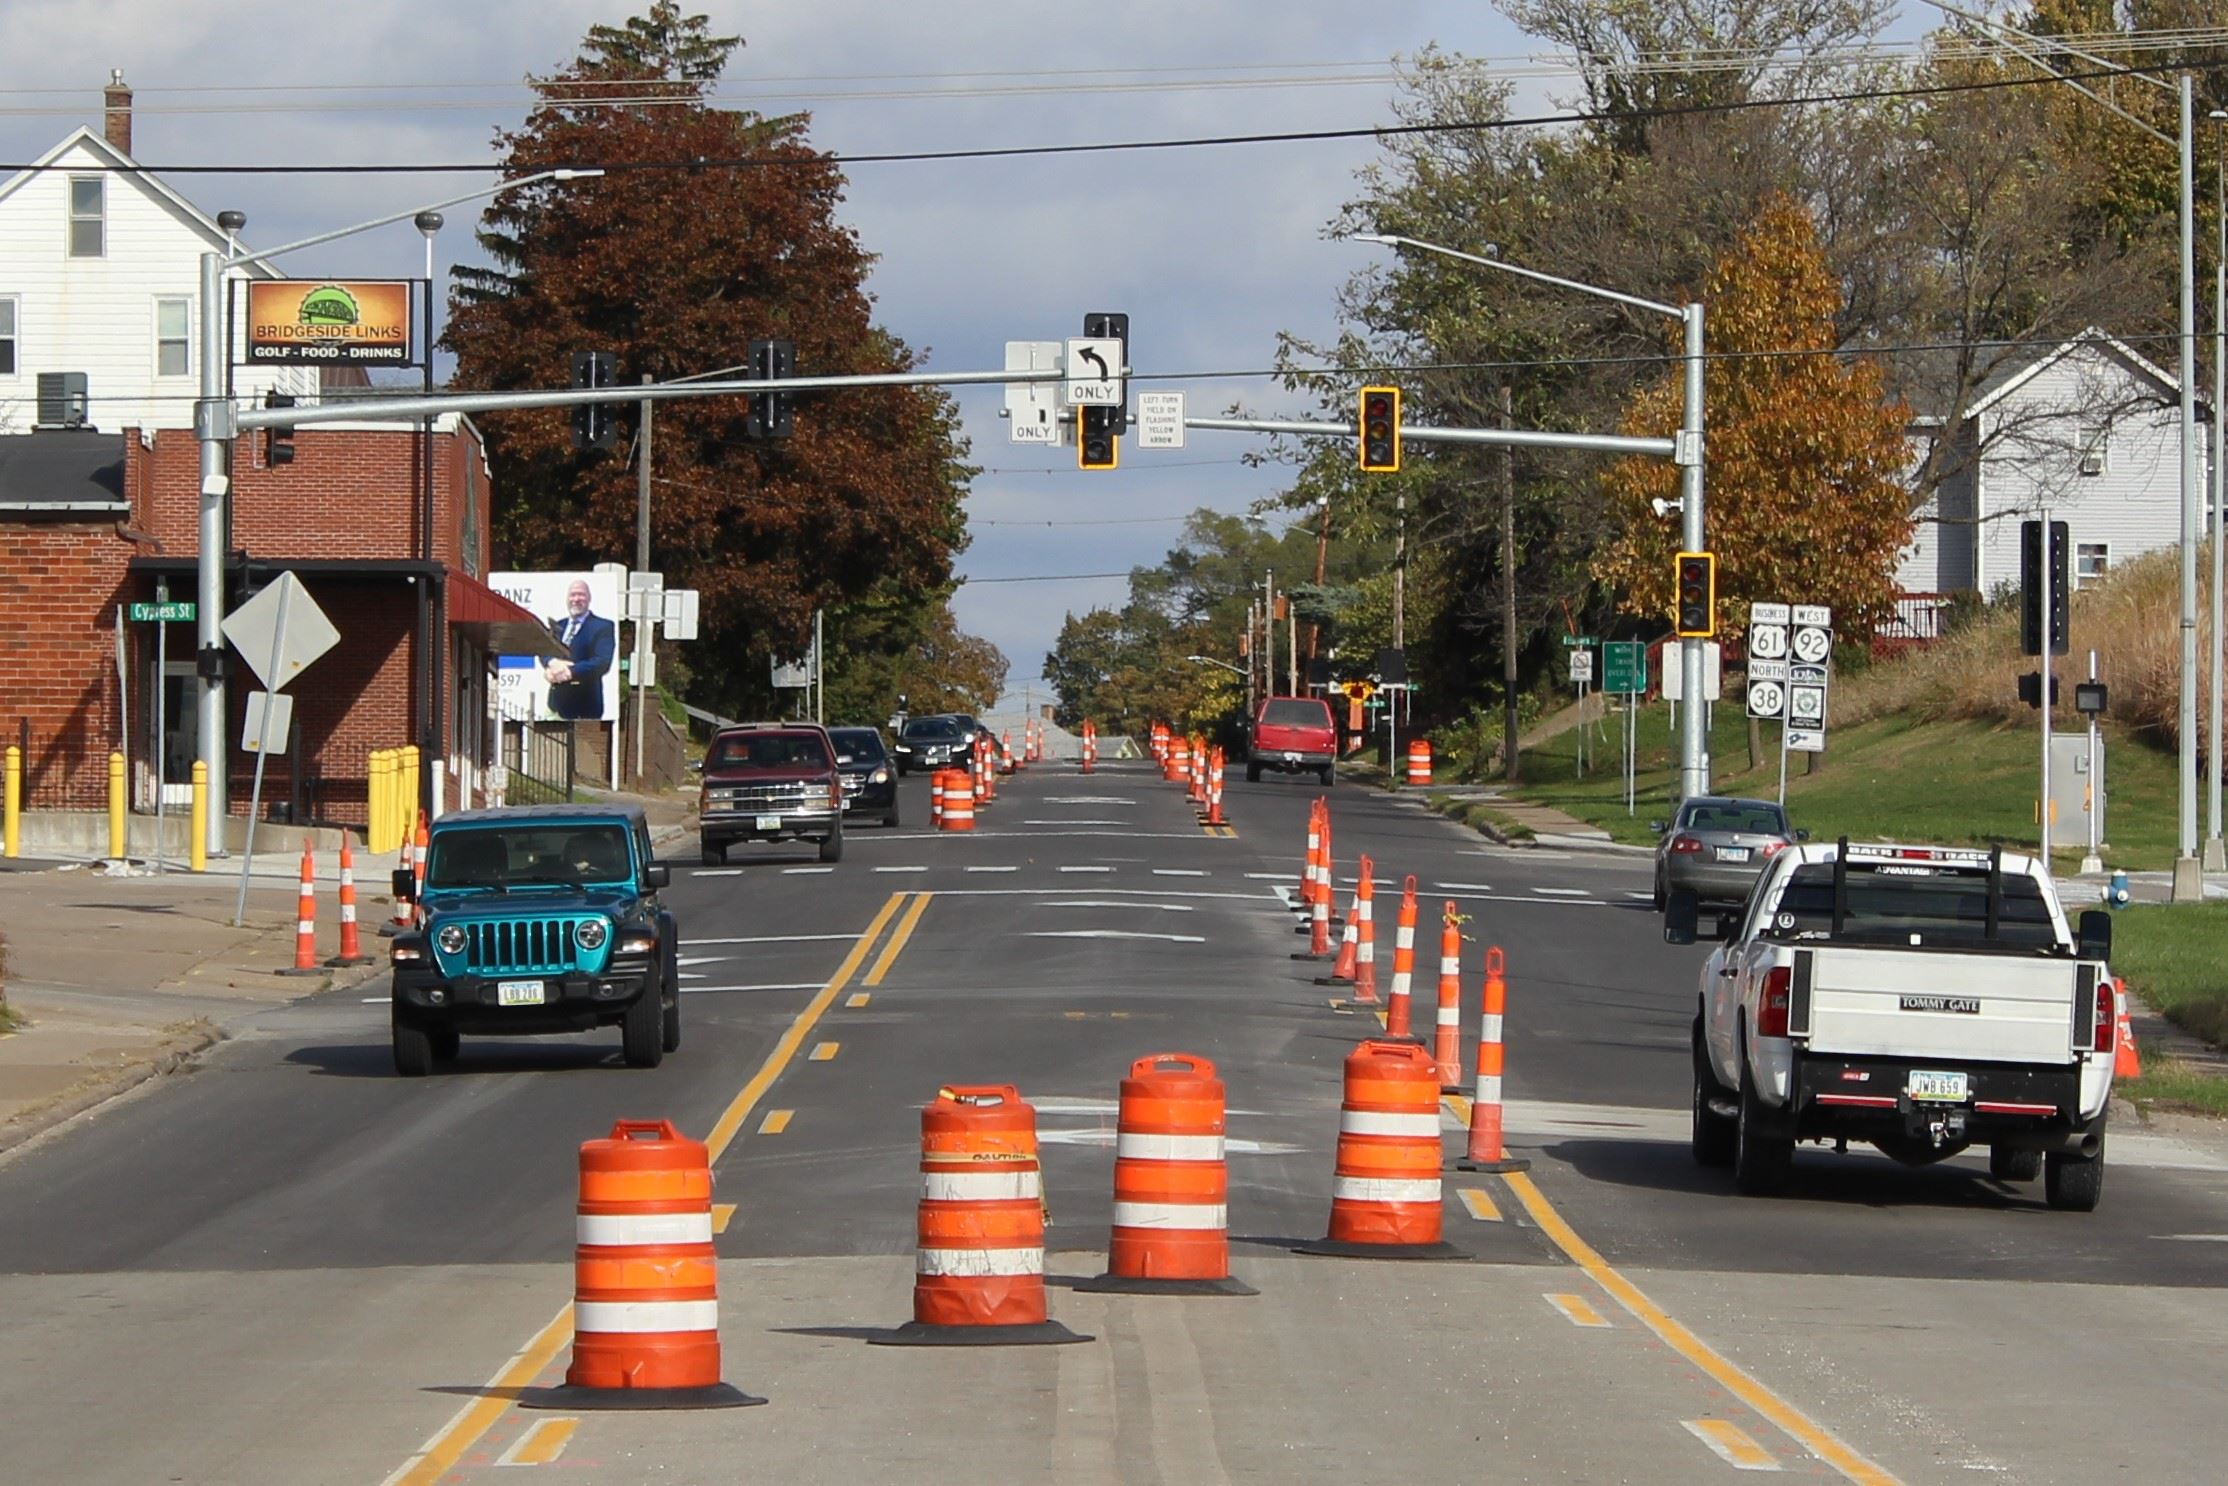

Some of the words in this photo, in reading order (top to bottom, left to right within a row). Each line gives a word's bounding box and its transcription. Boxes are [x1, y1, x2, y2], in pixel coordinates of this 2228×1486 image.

[256, 325, 350, 338] BRIDGESIDE
[356, 326, 401, 338] LINKS
[254, 347, 291, 358] GOLF
[301, 347, 339, 358] FOOD
[350, 348, 402, 359] DRINKS
[1074, 386, 1113, 400] ONLY
[1016, 426, 1051, 438] ONLY
[134, 603, 175, 621] Cypress
[178, 603, 190, 618] St
[1755, 608, 1786, 619] BUSINESS
[1798, 610, 1826, 623] WEST
[1758, 632, 1777, 651] 61
[1800, 632, 1825, 656] 92
[1751, 663, 1785, 677] NORTH
[1754, 688, 1778, 709] 38
[1902, 996, 1945, 1009] TOMMY
[1949, 999, 1978, 1012] GATE
[1916, 1080, 1936, 1094] JWB
[1940, 1081, 1959, 1094] 659
